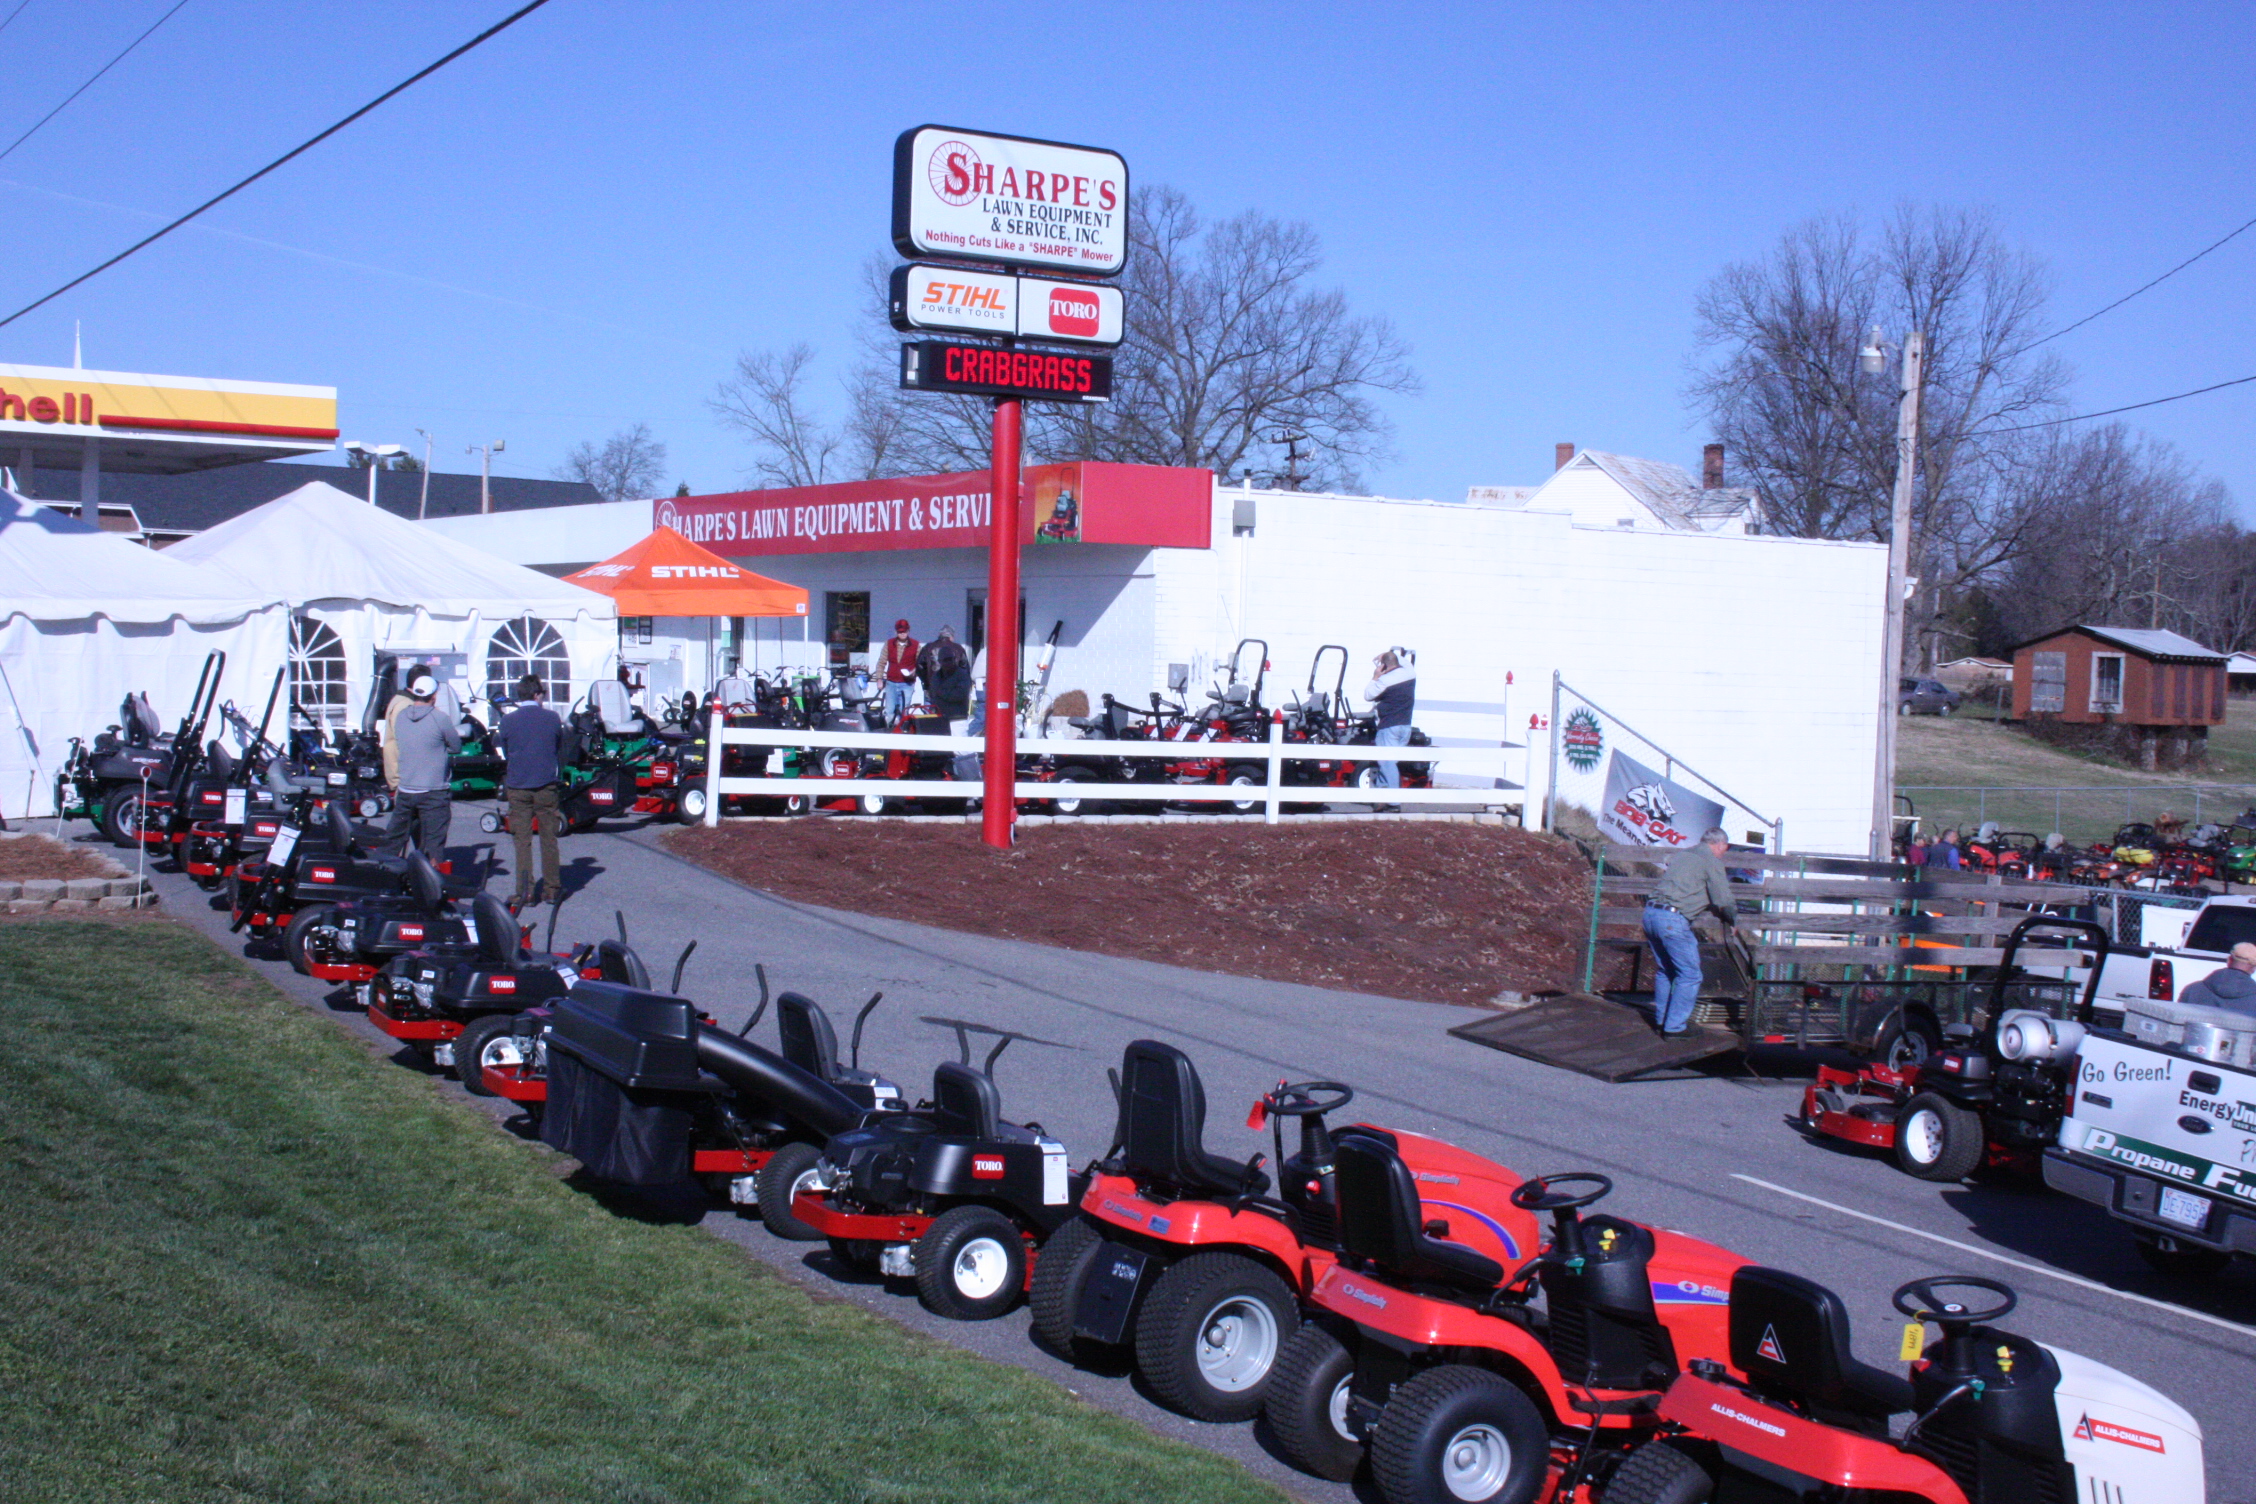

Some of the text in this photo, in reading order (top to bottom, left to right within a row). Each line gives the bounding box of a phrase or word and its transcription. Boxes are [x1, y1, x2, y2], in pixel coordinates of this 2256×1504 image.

[944, 151, 1117, 211] SHARPE'S
[982, 197, 1112, 228] LAWN EQUIPMENT
[991, 217, 1104, 245] & SERVICE, INC.
[925, 229, 966, 247] Nothing
[969, 234, 991, 248] Cuts
[995, 238, 1015, 251] Like
[1019, 243, 1025, 252] a
[1081, 248, 1114, 262] Mower
[922, 282, 1006, 310] STIHL
[1050, 299, 1098, 321] TORO
[921, 304, 1005, 319] POWER TOOLS
[945, 347, 1092, 392] CRABGRASS
[0, 387, 93, 425] hell
[741, 508, 788, 540] LAWN
[794, 498, 904, 541] EQUIPMENT
[908, 497, 923, 531] &
[929, 492, 991, 529] SERVI
[591, 792, 613, 800] TORO
[1614, 800, 1687, 845] BOB-CAT
[1616, 818, 1646, 846] Meane
[315, 870, 335, 878] TORO
[401, 927, 423, 936] TORO
[492, 980, 516, 989] TORO
[2082, 1059, 2172, 1082] Go Green!
[974, 1160, 1003, 1171] TORO
[2083, 1128, 2197, 1181] Propane
[1701, 1285, 1730, 1301] Simp
[1711, 1403, 1786, 1437] ALLIS-CHALMERS
[2094, 1424, 2162, 1449] ALLIS-CHALMERS
